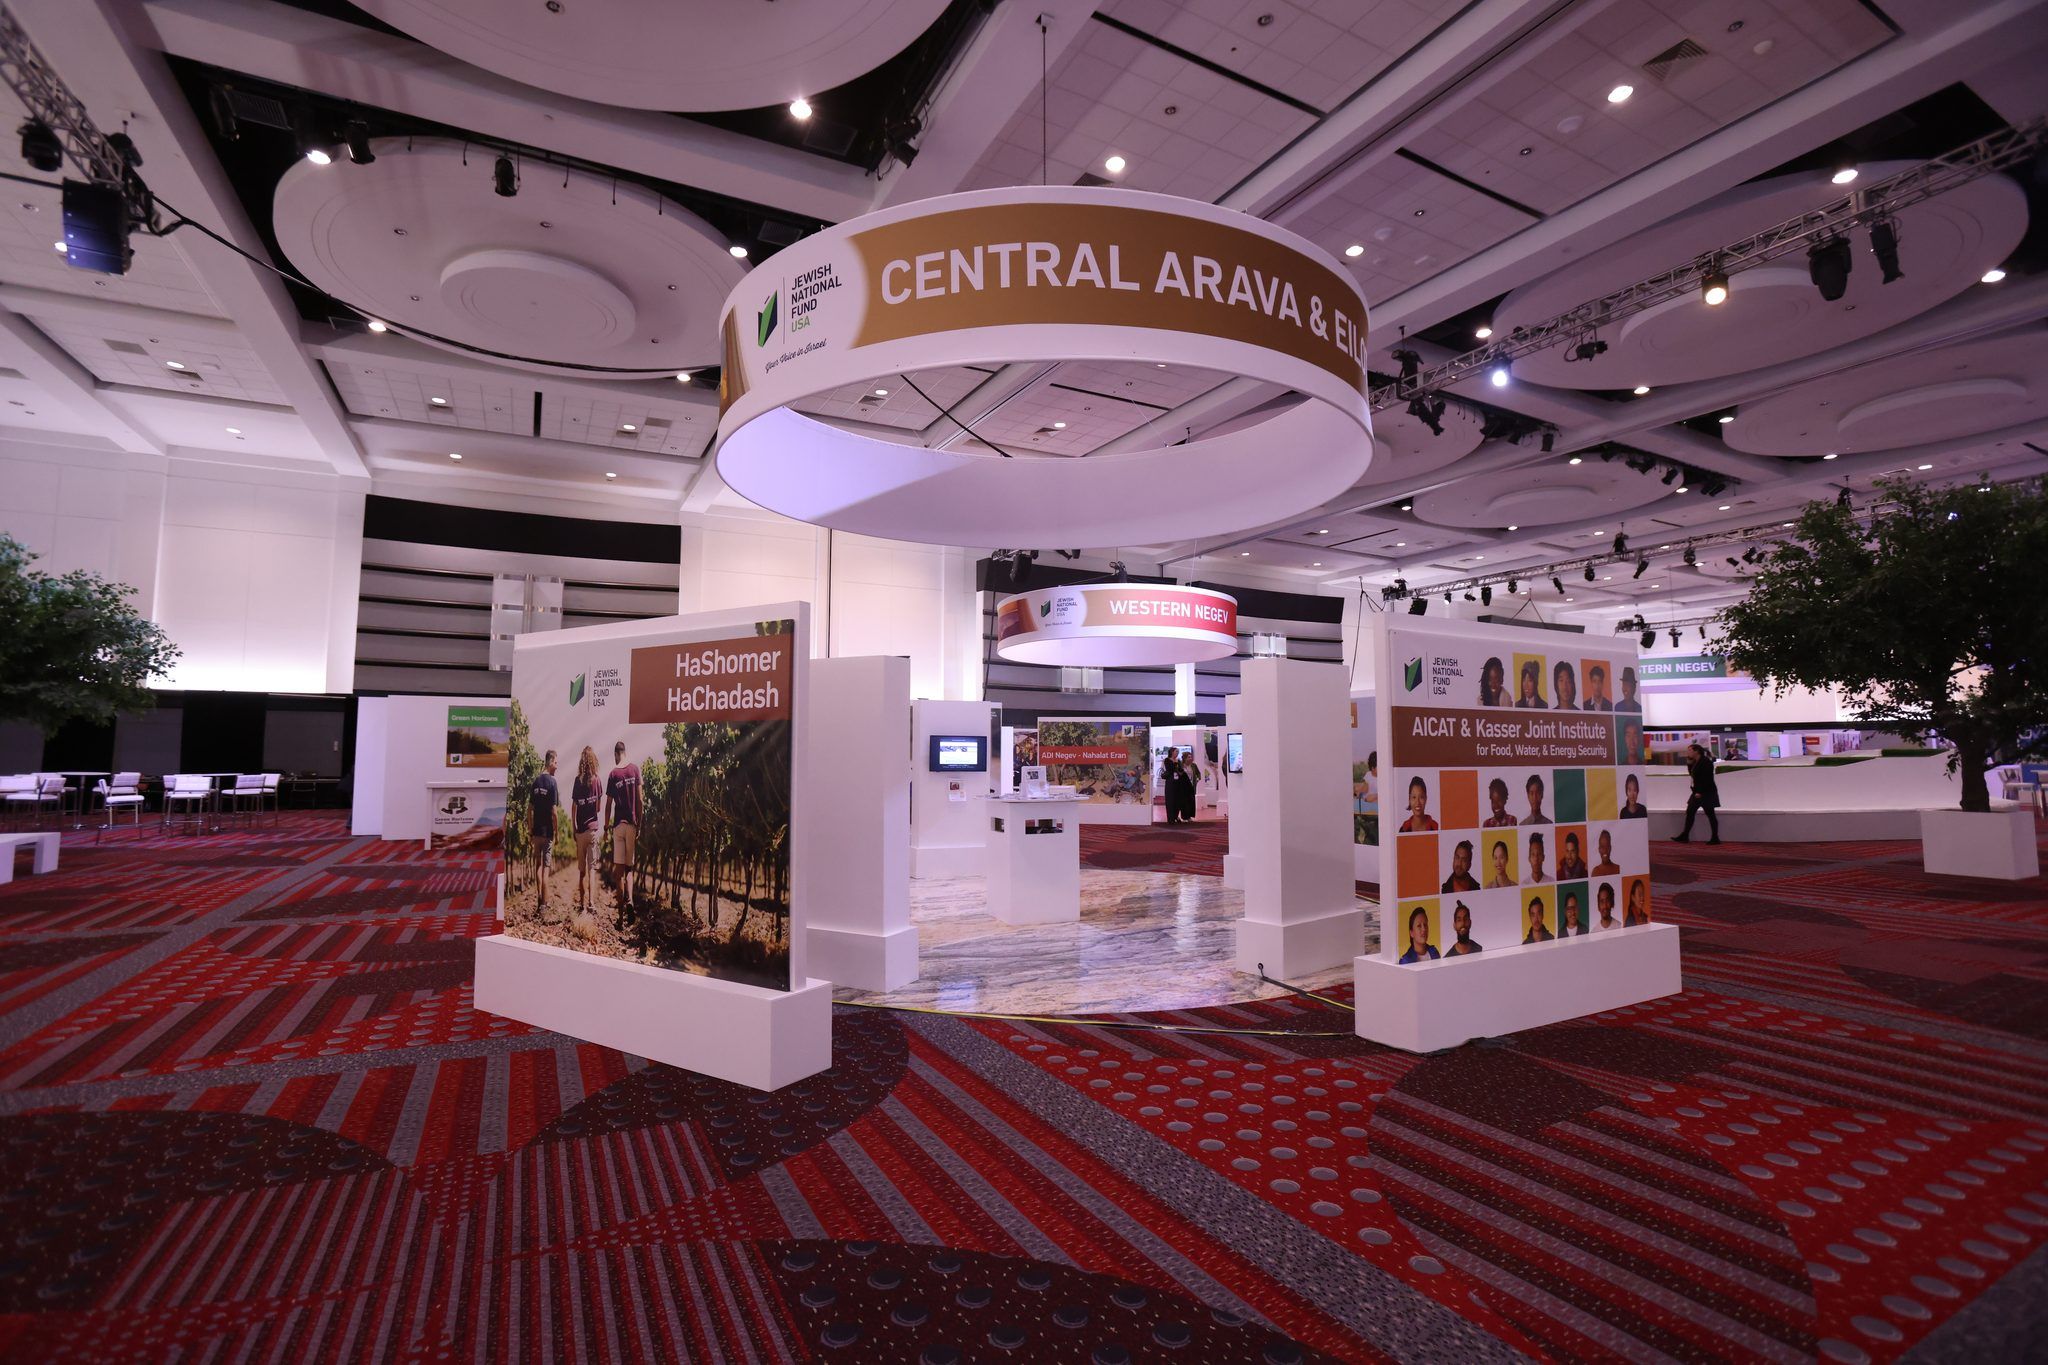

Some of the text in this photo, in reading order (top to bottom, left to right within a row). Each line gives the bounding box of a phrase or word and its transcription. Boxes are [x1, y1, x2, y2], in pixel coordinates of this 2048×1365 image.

[791, 263, 832, 291] JEWISH
[791, 275, 842, 305] NATIONAL
[881, 242, 1141, 305] CENTRAL
[1154, 251, 1303, 328] ARAVA
[1309, 295, 1330, 341] &
[791, 298, 818, 319] FUND
[791, 315, 811, 333] USA
[1109, 600, 1229, 624] WESTERN NEGEV
[676, 649, 781, 677] HaShomer
[1432, 657, 1458, 667] JEWISH
[594, 668, 618, 679] JEWISH
[1432, 667, 1464, 677] NATIONAL
[593, 678, 623, 688] NATIONAL
[1432, 676, 1451, 686] FUND
[593, 688, 610, 697] FUND
[667, 681, 779, 712] HaChadash
[1433, 686, 1447, 695] USA
[593, 698, 606, 707] USA
[1412, 716, 1606, 739] AICAT & Kasser Joint Institute
[1055, 752, 1077, 760] Negev
[1082, 751, 1109, 759] Nahalat
[1110, 751, 1127, 759] Eran
[1476, 743, 1607, 758] for Food, Water, & Energy Security
